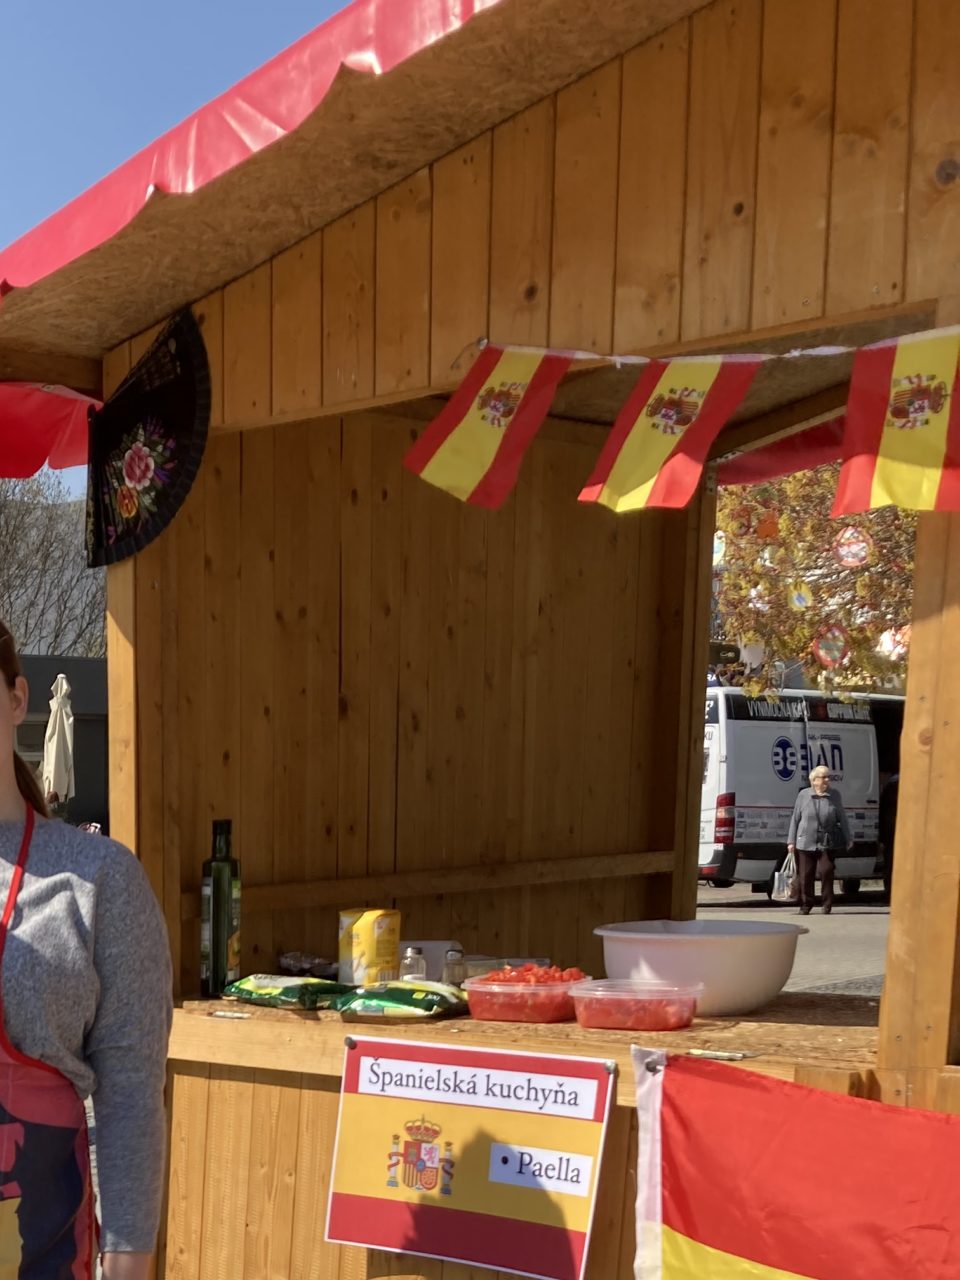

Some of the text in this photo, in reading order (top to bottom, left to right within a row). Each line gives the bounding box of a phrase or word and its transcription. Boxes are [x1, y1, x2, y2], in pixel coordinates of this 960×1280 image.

[368, 1056, 580, 1110] Španielská kuchyňa
[516, 1150, 582, 1184] Paella
